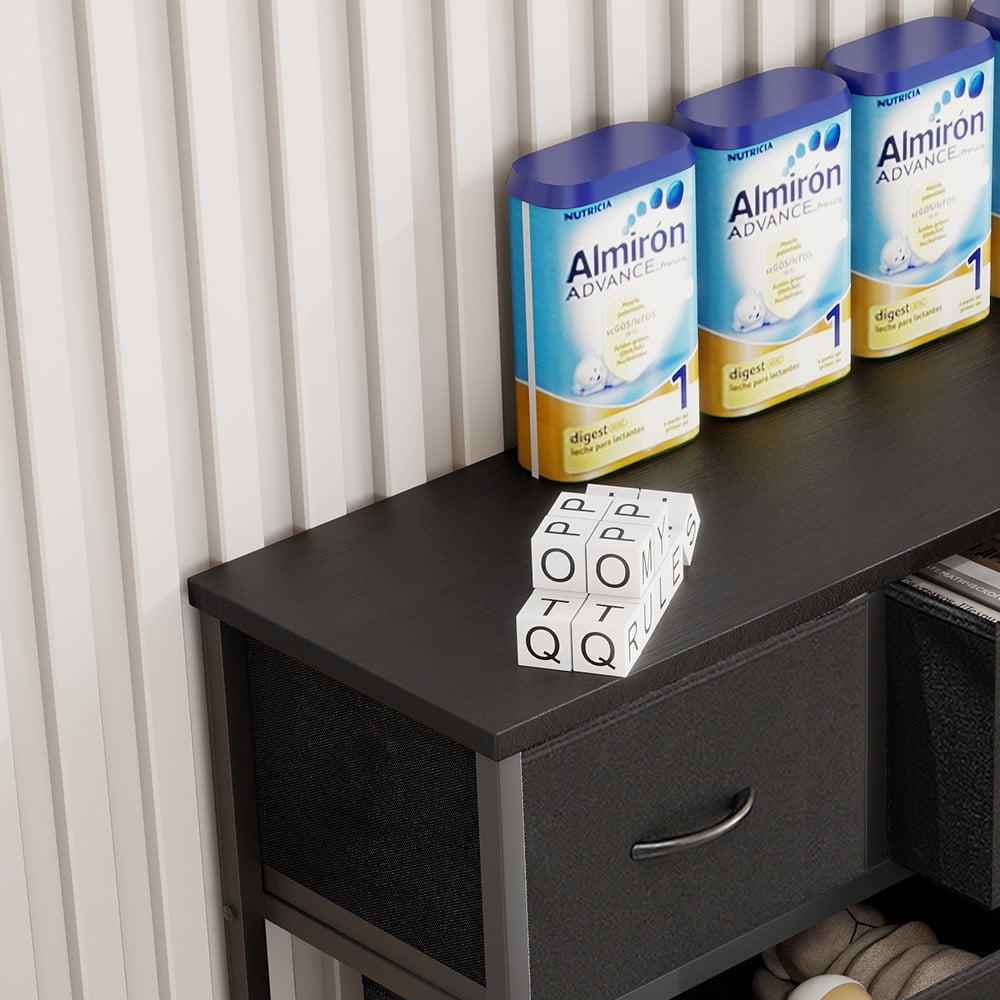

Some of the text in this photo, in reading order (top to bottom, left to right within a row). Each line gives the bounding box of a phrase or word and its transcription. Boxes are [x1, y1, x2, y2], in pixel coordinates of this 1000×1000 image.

[877, 89, 921, 107] NUTRICIA
[727, 142, 773, 162] NUTRICIA
[877, 109, 984, 167] Almirón
[876, 145, 956, 184] ADVANCE
[728, 163, 841, 223] Almirón
[564, 200, 612, 221] NUTRICIA
[727, 199, 812, 240] ADVANCE
[566, 220, 685, 283] Almirón
[565, 258, 655, 301] ADVANCE
[968, 248, 981, 291] 1
[826, 304, 840, 347] 1
[875, 304, 910, 322] digest
[898, 316, 912, 330] para
[913, 305, 943, 321] lactantes
[671, 364, 687, 409] 1
[729, 361, 765, 380] digest
[753, 374, 769, 387] para
[769, 363, 800, 379] lactantes
[570, 425, 608, 445] digest
[596, 440, 611, 452] para
[613, 425, 645, 443] lactantes
[541, 548, 575, 582] O
[596, 554, 630, 588] O
[541, 598, 569, 616] T
[596, 604, 624, 622] T
[526, 626, 560, 664] Q
[581, 632, 615, 670] Q
